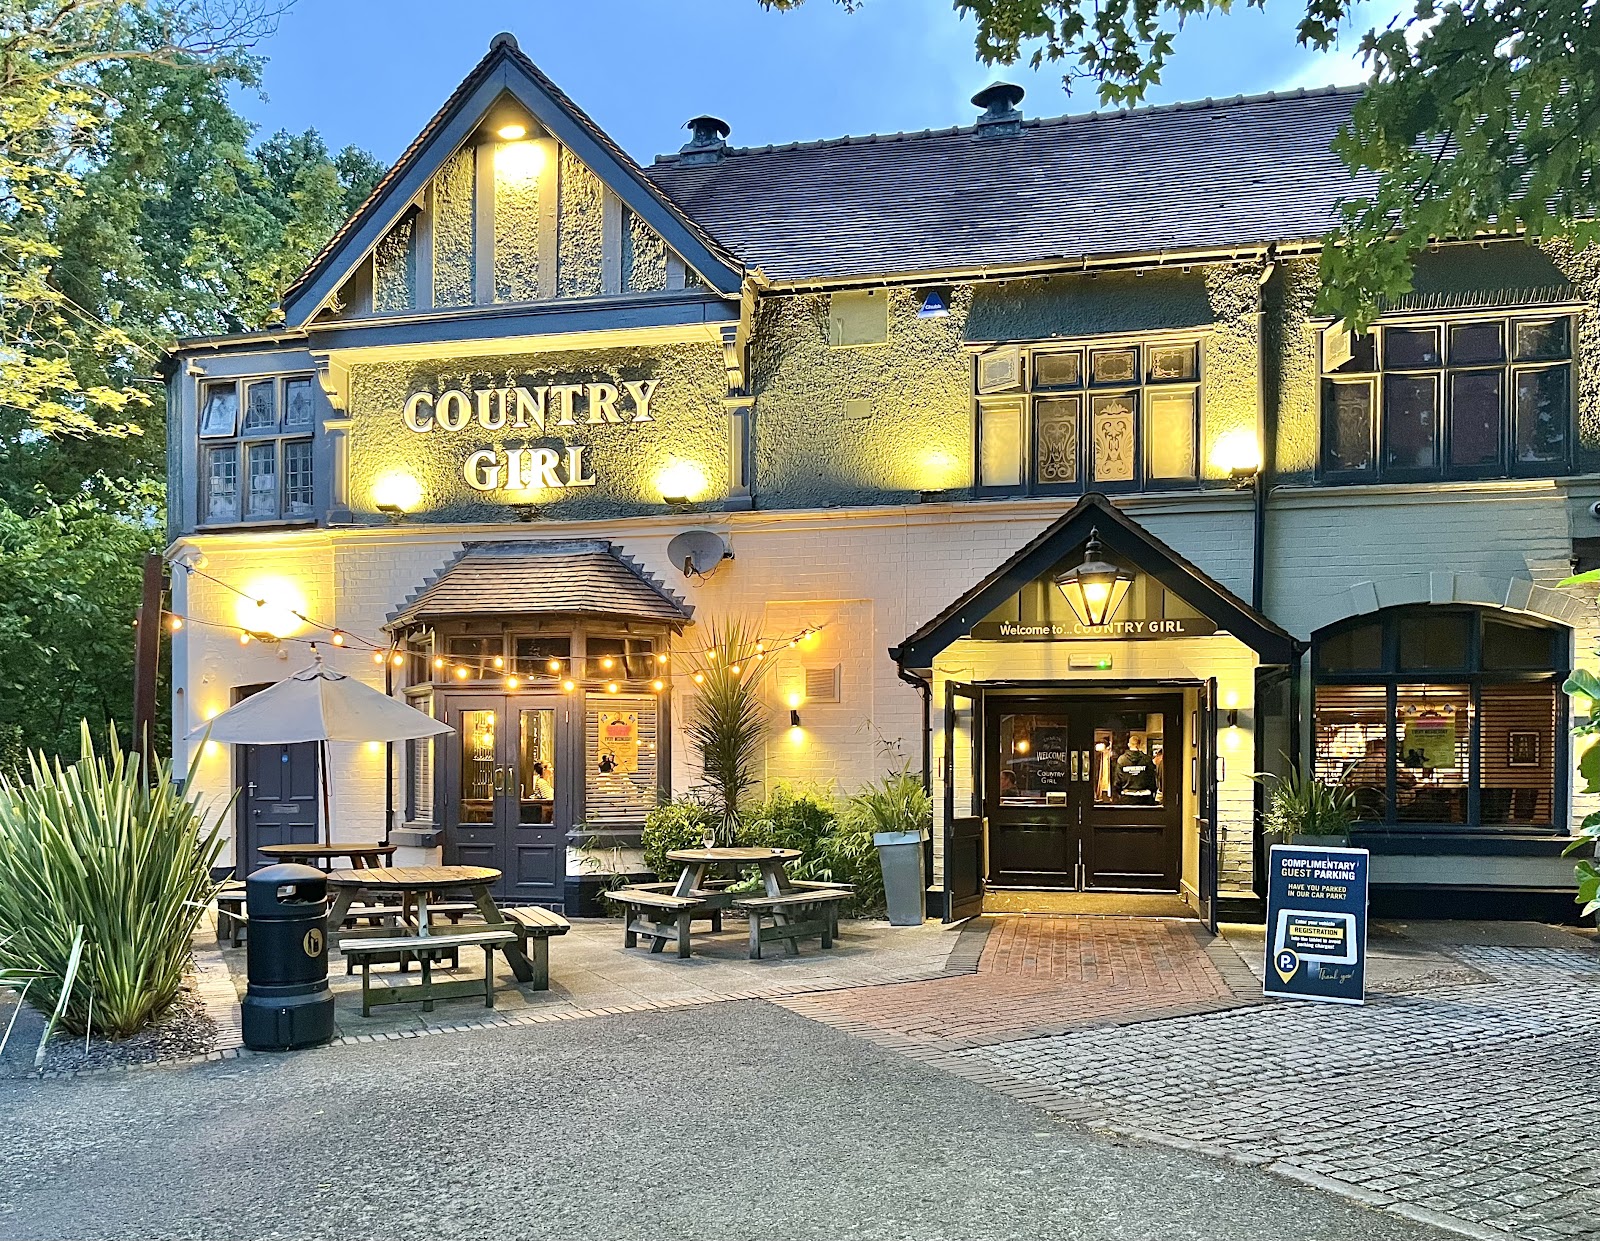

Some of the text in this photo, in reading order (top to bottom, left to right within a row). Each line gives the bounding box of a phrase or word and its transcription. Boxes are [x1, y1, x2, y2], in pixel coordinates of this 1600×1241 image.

[403, 378, 662, 433] COUNTRY
[463, 446, 597, 491] GIRL
[1000, 623, 1050, 636] Welcome
[1073, 621, 1144, 635] COUNTRY
[1148, 620, 1185, 633] GIRL
[1036, 751, 1067, 763] WELCOME
[1040, 776, 1058, 785] GIRL
[1281, 858, 1356, 870] COMPLIMENTARY
[1281, 868, 1356, 881] GUEST PARKING
[1288, 883, 1305, 891] HAVE
[1321, 885, 1347, 893] PARKED
[1296, 890, 1310, 898] OUR
[1326, 892, 1347, 900] PARK?
[1294, 927, 1338, 936] REGISTRATION
[1315, 967, 1338, 980] Thank
